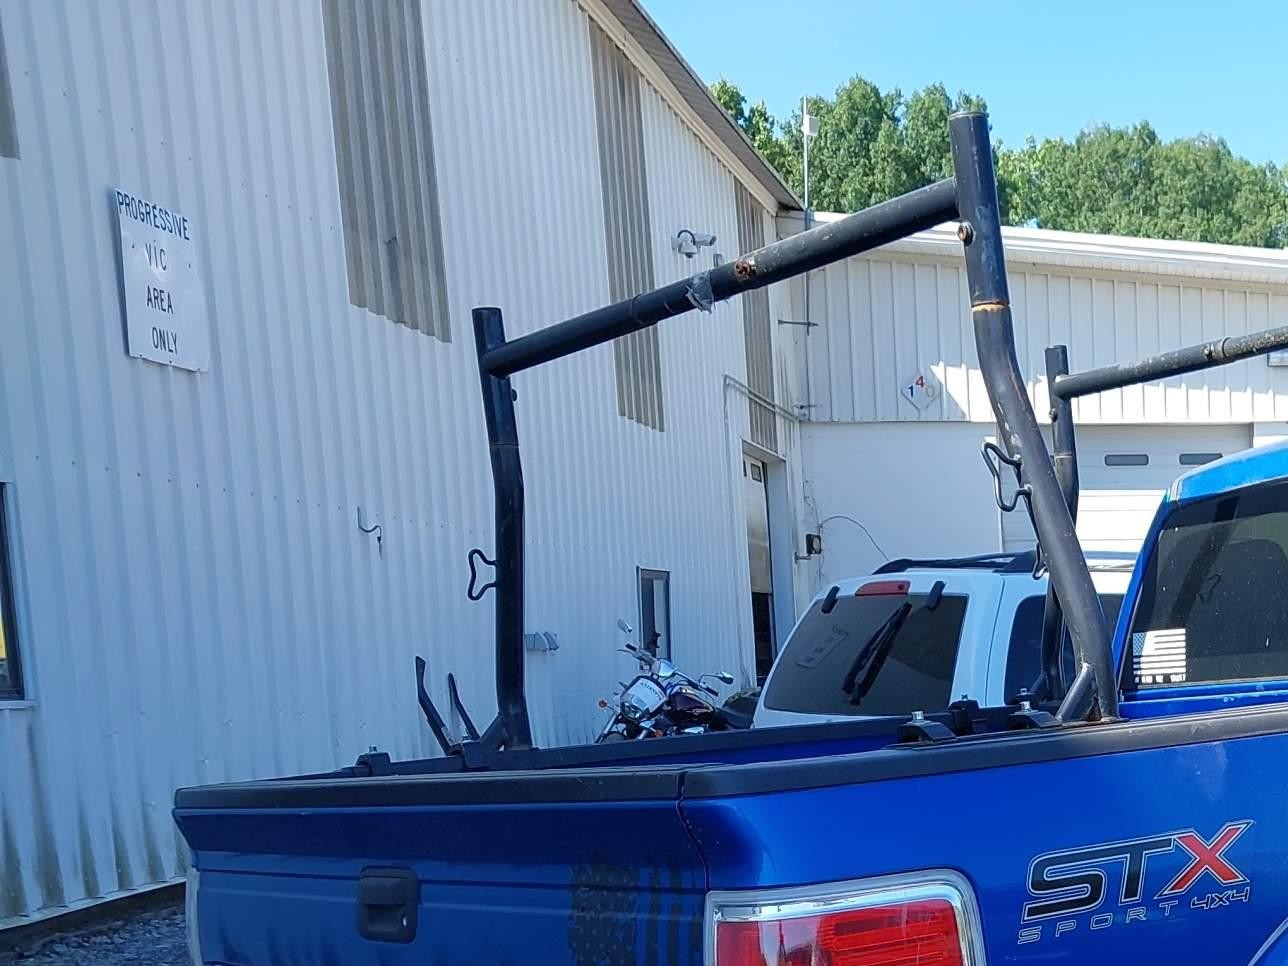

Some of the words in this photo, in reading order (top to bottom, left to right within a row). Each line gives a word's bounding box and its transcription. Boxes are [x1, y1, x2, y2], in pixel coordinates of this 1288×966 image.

[116, 191, 190, 241] PROGRESSIVE
[144, 242, 167, 271] VIC
[146, 285, 174, 315] AREA
[151, 326, 178, 355] ONLY
[907, 385, 914, 398] 1
[915, 375, 925, 388] 4
[1021, 819, 1256, 925] STX
[1017, 900, 1179, 945] SPORT
